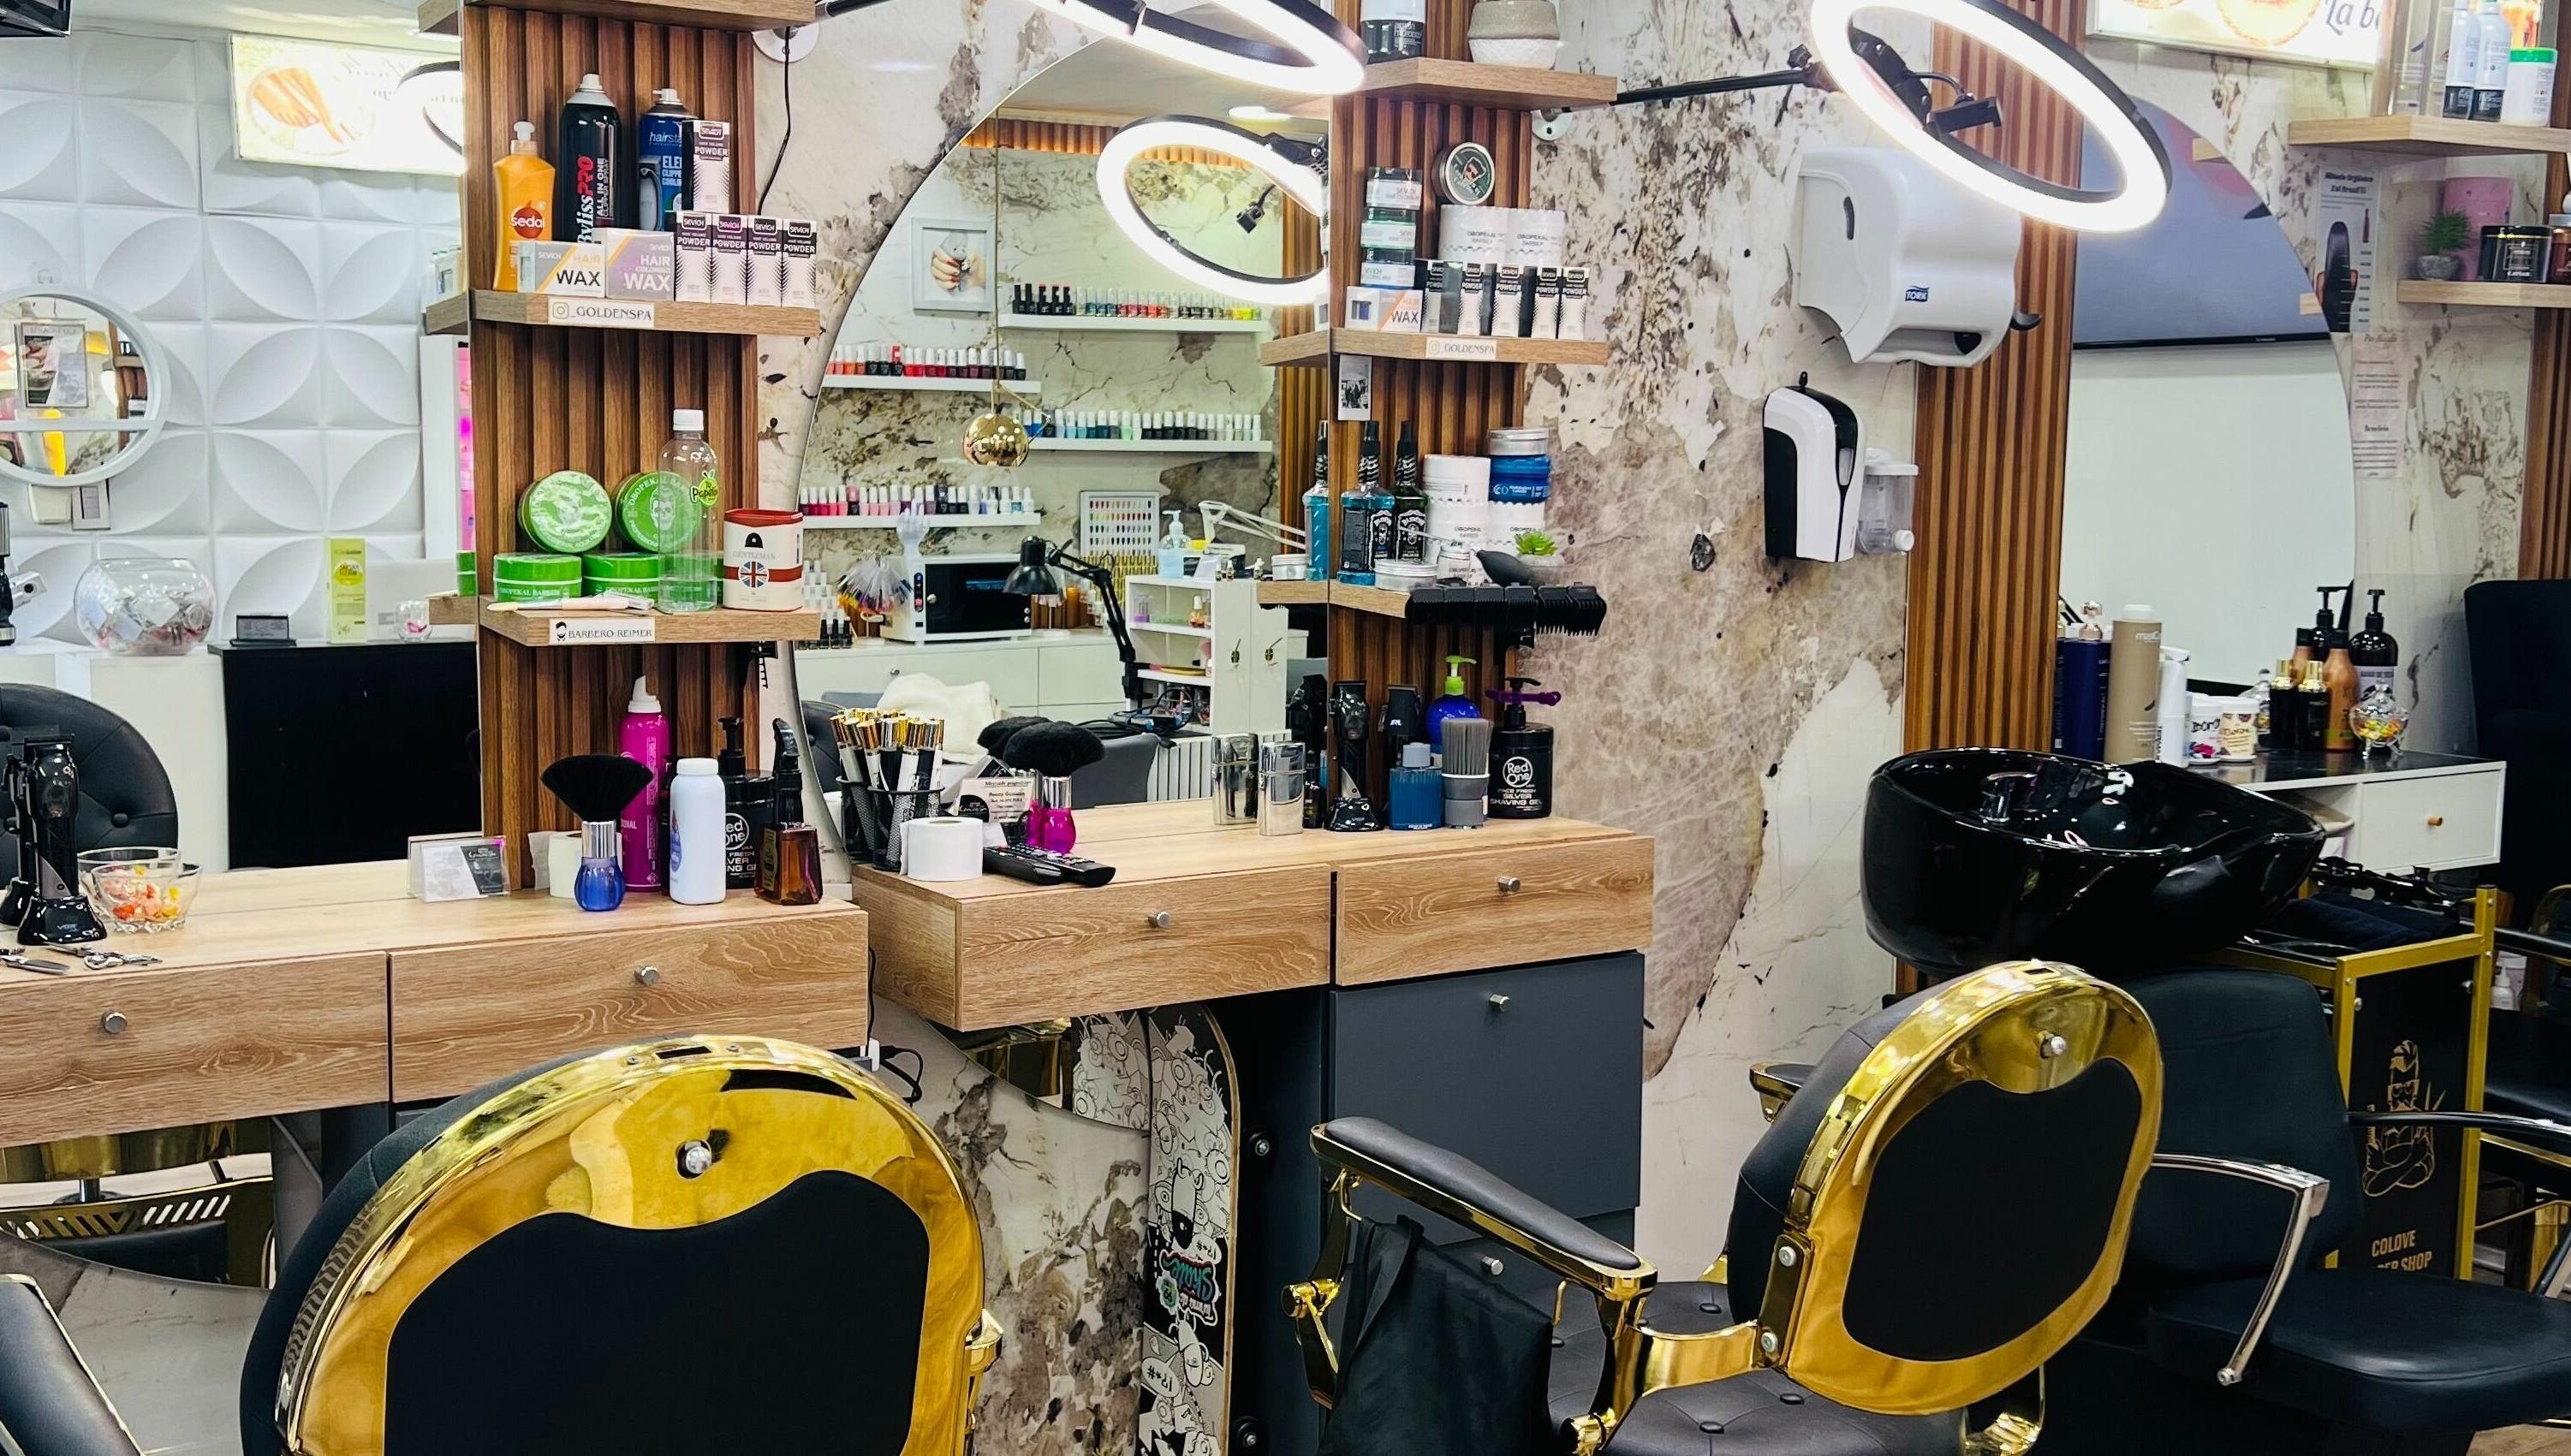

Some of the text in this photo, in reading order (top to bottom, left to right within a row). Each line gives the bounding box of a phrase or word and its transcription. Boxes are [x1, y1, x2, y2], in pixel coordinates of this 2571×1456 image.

[650, 131, 682, 144] hairsta
[694, 146, 728, 156] POWDER
[576, 155, 594, 243] BylissPRO
[677, 237, 711, 247] POWDER
[712, 240, 746, 248] POWDER
[748, 241, 781, 251] POWDER
[783, 244, 816, 253] POWDER
[640, 254, 671, 267] HAIR
[556, 270, 601, 287] WAX
[624, 272, 671, 292] WAX
[1906, 291, 1928, 300] TORK
[1391, 311, 1419, 324] WAX
[1507, 762, 1530, 774] Red
[1507, 773, 1530, 784] One
[725, 820, 744, 833] ed
[2372, 1229, 2416, 1257] COLOVE
[2401, 1251, 2433, 1272] SHOP
